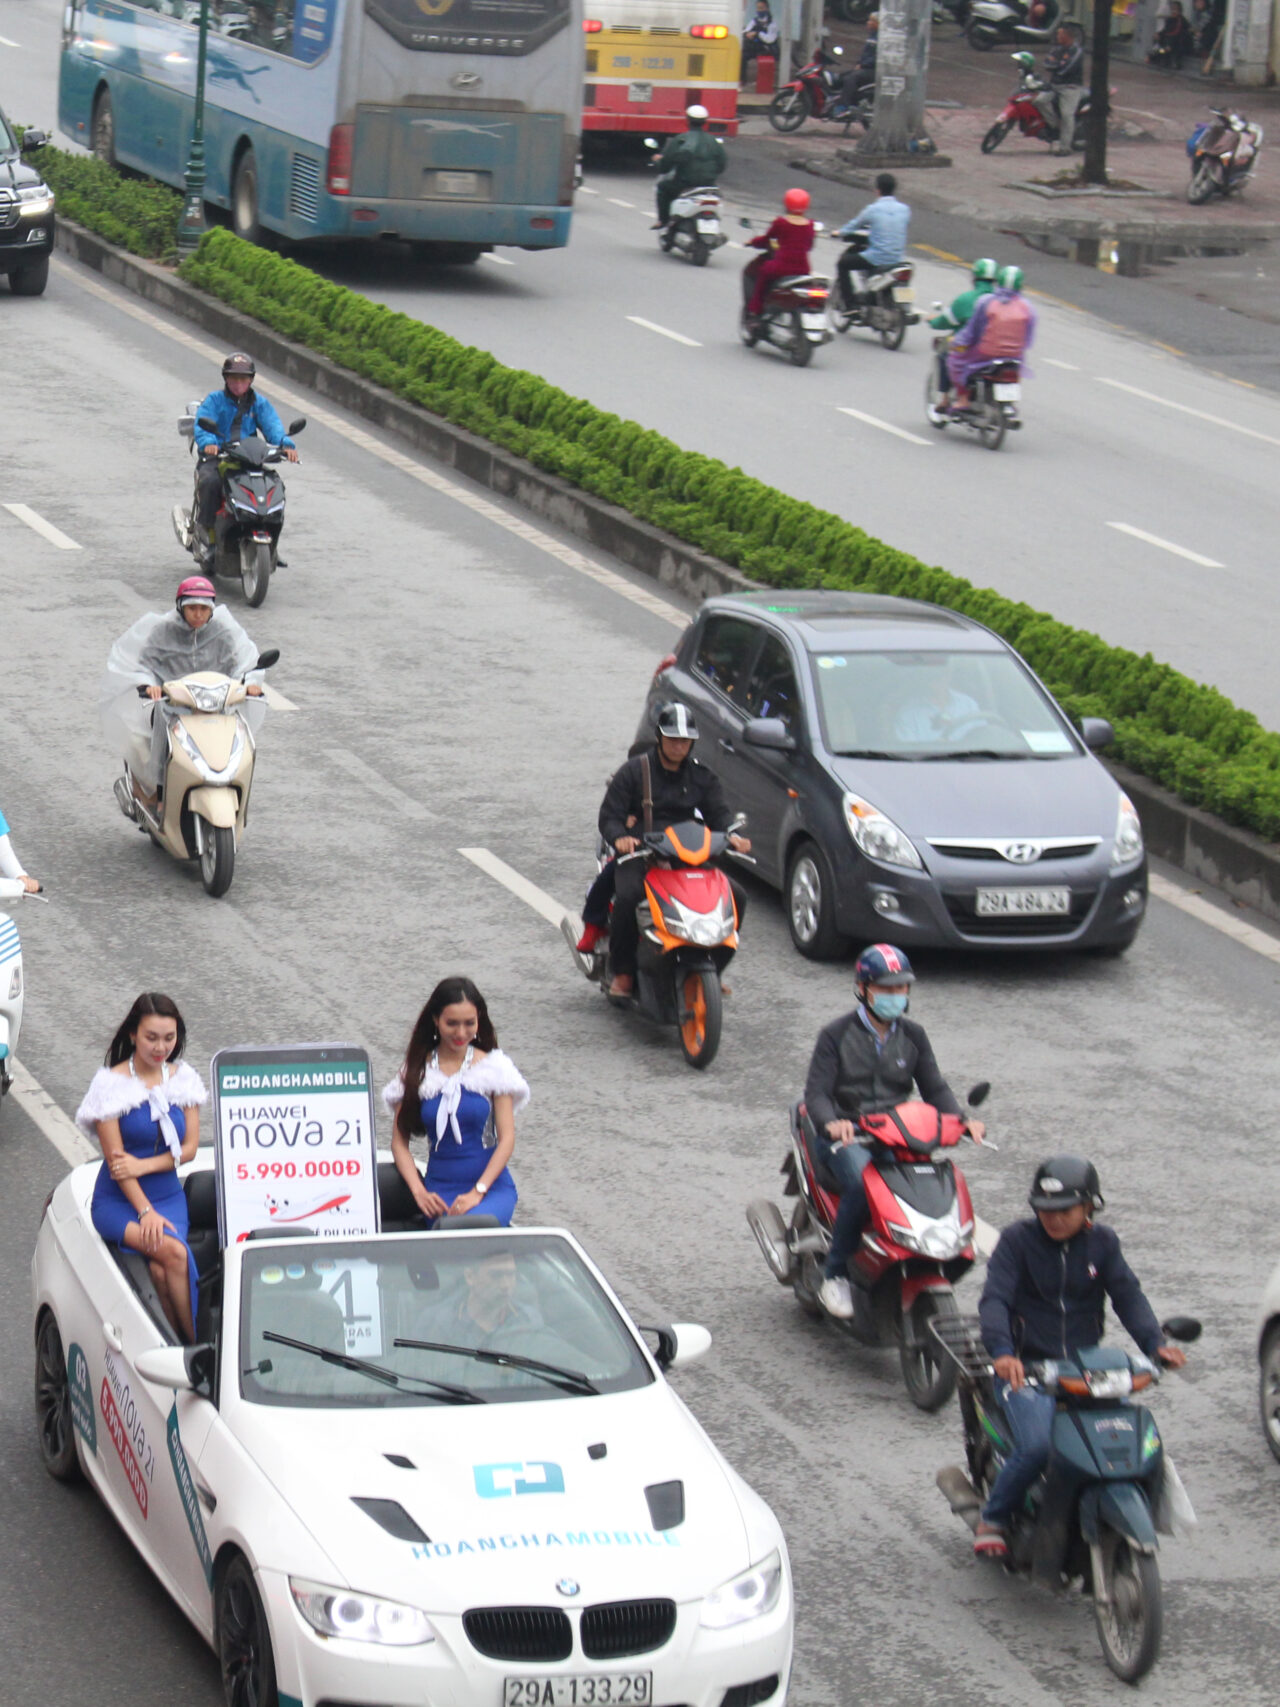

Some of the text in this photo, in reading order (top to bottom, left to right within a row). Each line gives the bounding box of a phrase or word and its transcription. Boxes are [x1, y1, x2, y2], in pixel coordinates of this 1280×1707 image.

[411, 34, 525, 48] UNIVERSE
[241, 1071, 367, 1089] HOANGHAMOBILE
[229, 1105, 307, 1121] HUAWEI
[229, 1119, 361, 1149] nova 2i
[237, 1160, 361, 1180] 5.990.000Đ
[120, 1385, 145, 1457] nova
[411, 1530, 682, 1560] HOANGHAMOBILE
[510, 1676, 648, 1706] 29A-133.29
